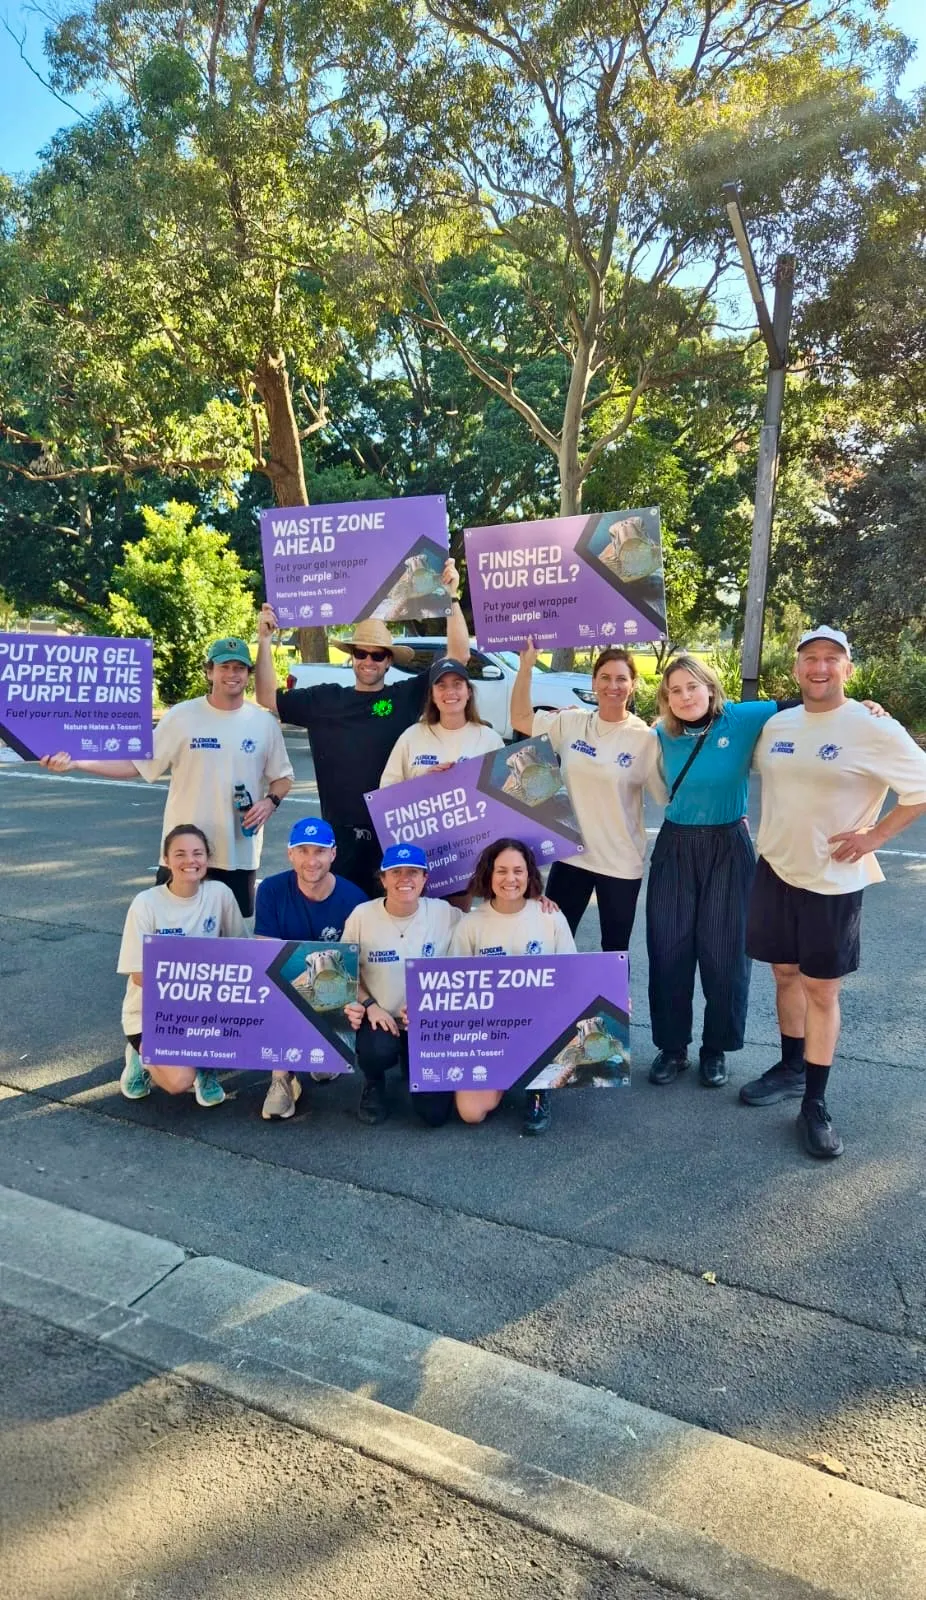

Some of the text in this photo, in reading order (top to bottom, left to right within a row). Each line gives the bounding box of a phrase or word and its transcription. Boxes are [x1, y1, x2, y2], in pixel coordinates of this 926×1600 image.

[272, 512, 386, 537] WASTE ZONE
[273, 536, 336, 556] AHEAD
[275, 558, 368, 572] Put your gel wrapper
[478, 545, 562, 570] FINISHED
[286, 574, 300, 582] the
[303, 572, 332, 584] purple
[334, 570, 350, 580] bin.
[481, 564, 580, 590] YOUR GEL?
[324, 587, 346, 596] Tosser!
[483, 596, 578, 612] Put your gel wrapper
[484, 610, 560, 624] in the purple bin.
[488, 636, 508, 644] Nature
[0, 643, 140, 665] PUT YOUR GEL
[1, 664, 142, 684] APPER IN THE
[8, 684, 142, 704] PURPLE BINS
[6, 708, 28, 718] Fuel
[29, 710, 51, 720] your
[53, 710, 72, 718] run.
[74, 710, 91, 718] Not
[94, 710, 110, 718] the
[384, 788, 466, 828] FINISHED
[390, 801, 487, 844] YOUR GEL?
[427, 830, 490, 856] ur gel wrapper
[428, 854, 458, 870] purple
[430, 880, 448, 890] Hates
[156, 961, 252, 982] FINISHED
[419, 968, 556, 990] WASTE ZONE
[158, 982, 270, 1004] YOUR GEL?
[418, 992, 494, 1012] AHEAD
[156, 1012, 264, 1027] Put your gel wrapper
[420, 1018, 532, 1030] Put your gel wrapper
[156, 1024, 242, 1038] in the purple bin.
[421, 1030, 510, 1043] in the purple bin.
[155, 1048, 180, 1056] Nature
[181, 1049, 202, 1057] Hates
[210, 1050, 236, 1059] Tosser!
[420, 1050, 446, 1058] Nature
[477, 1048, 504, 1056] Tosser!
